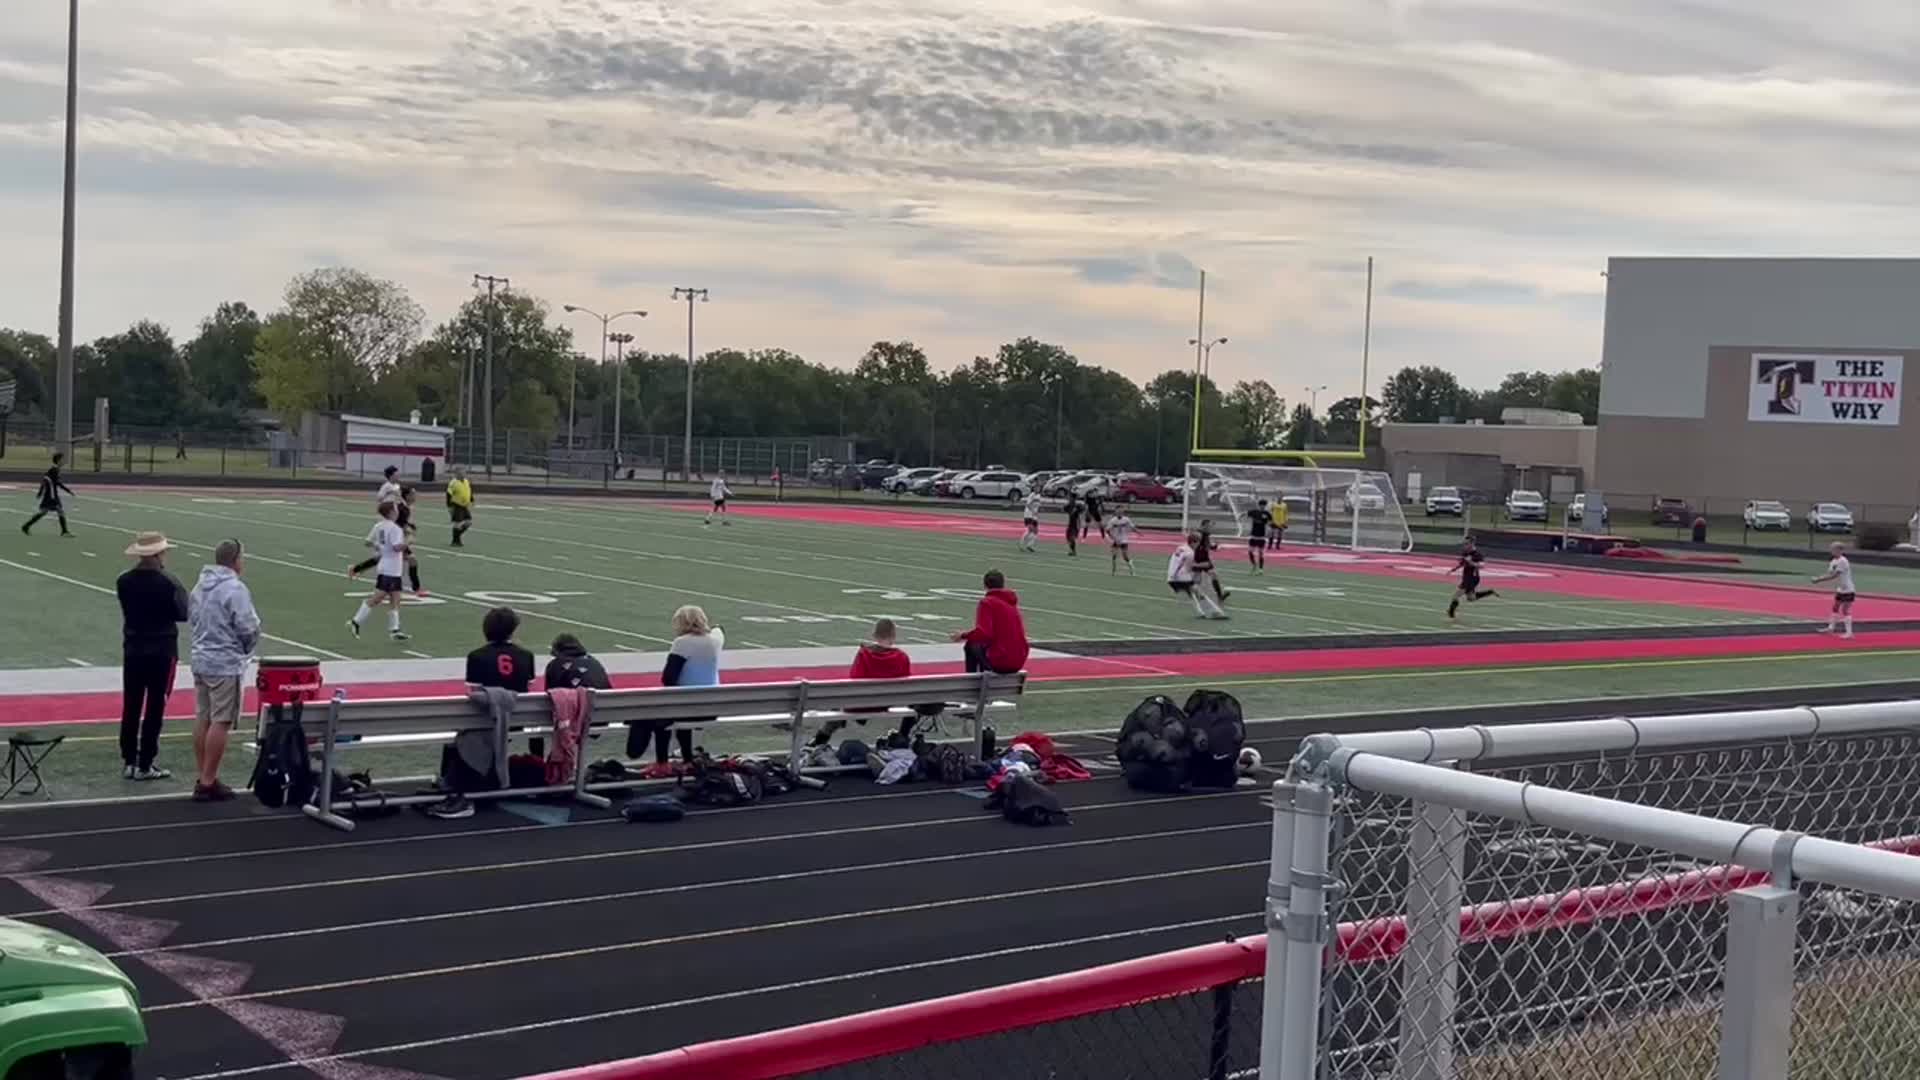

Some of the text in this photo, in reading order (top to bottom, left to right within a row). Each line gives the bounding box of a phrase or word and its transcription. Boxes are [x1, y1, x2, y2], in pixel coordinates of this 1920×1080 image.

[1836, 360, 1884, 377] THE
[1822, 380, 1896, 399] TITAN
[1832, 402, 1883, 420] WAY
[497, 654, 513, 675] 6
